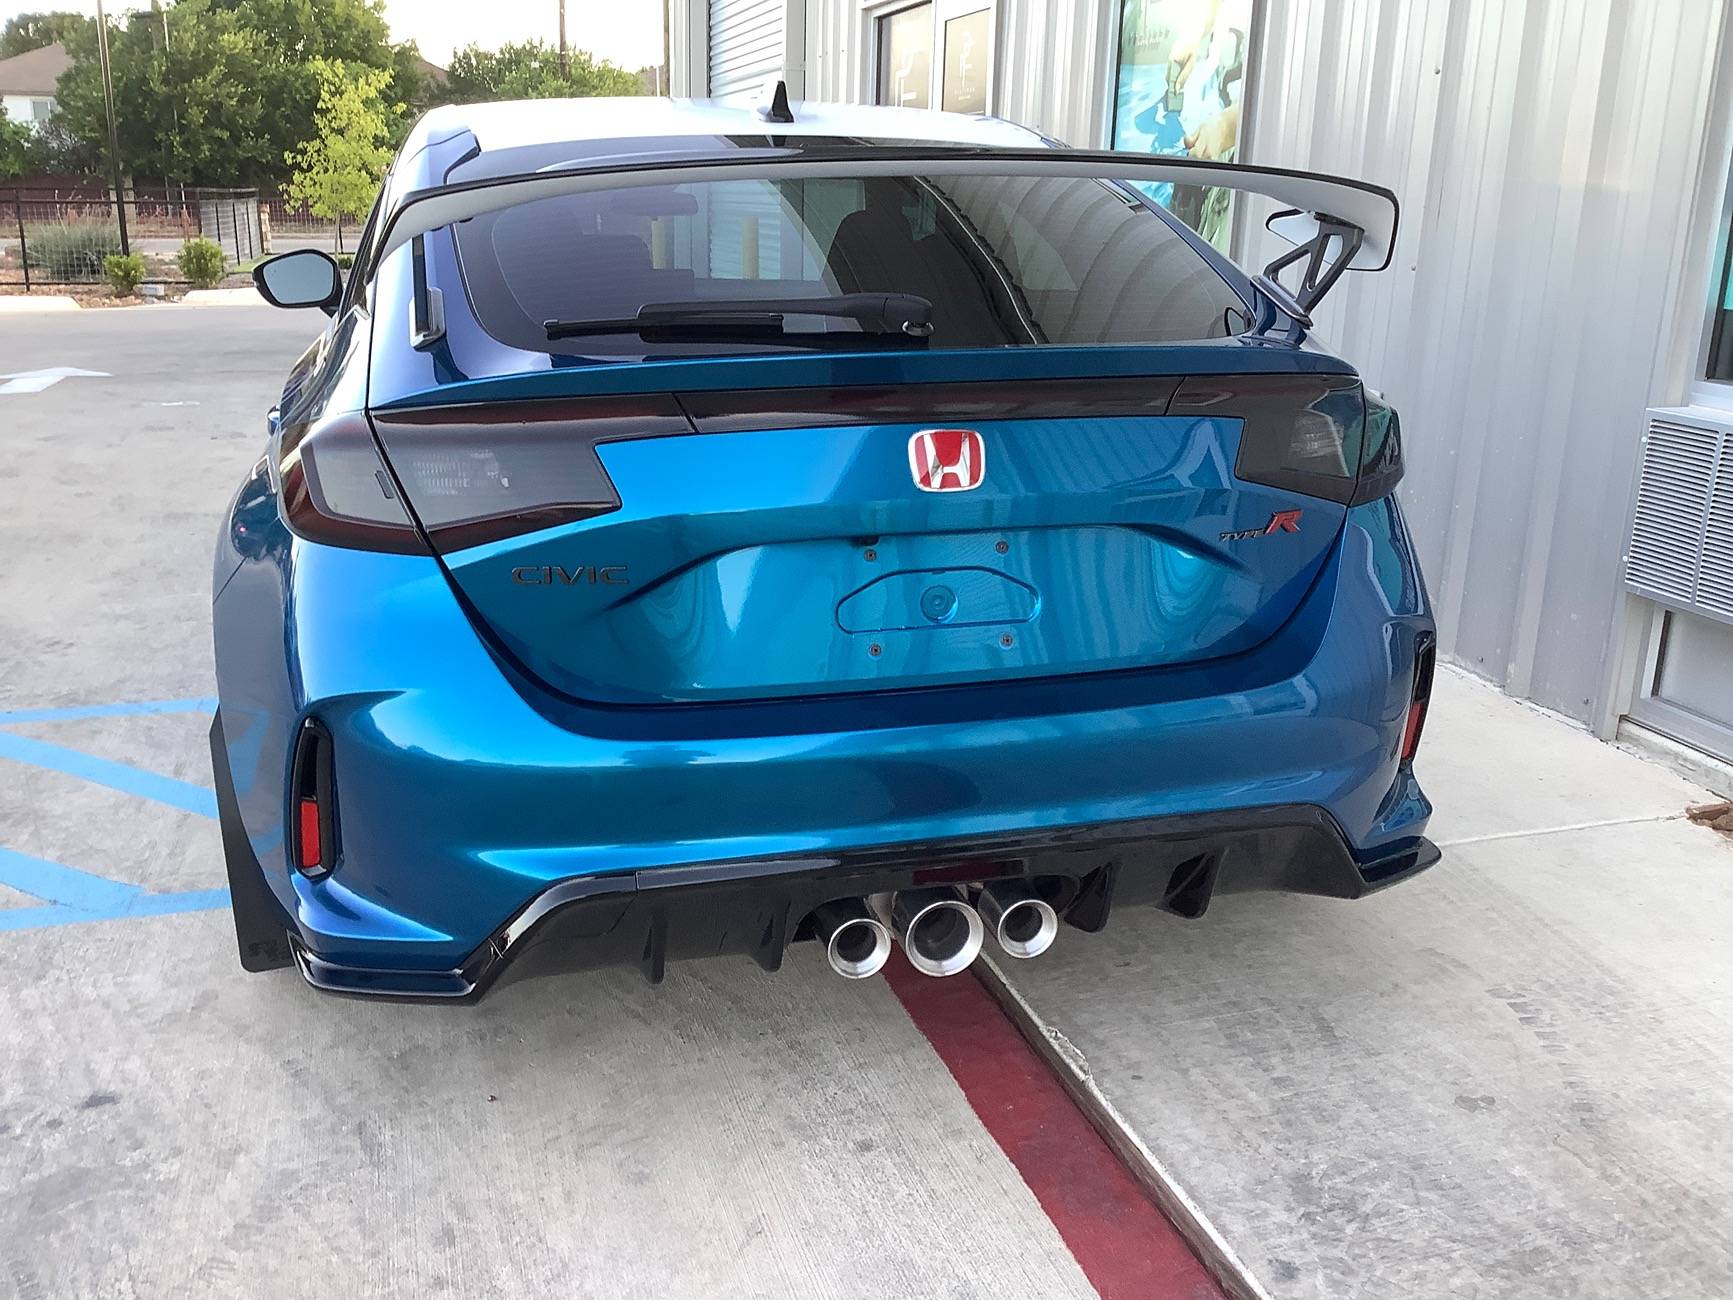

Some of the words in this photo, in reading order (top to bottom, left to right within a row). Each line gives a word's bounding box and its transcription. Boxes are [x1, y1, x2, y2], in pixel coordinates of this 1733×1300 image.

[1219, 528, 1265, 541] TYPE
[1264, 509, 1303, 535] R
[511, 566, 629, 584] CIVIC
